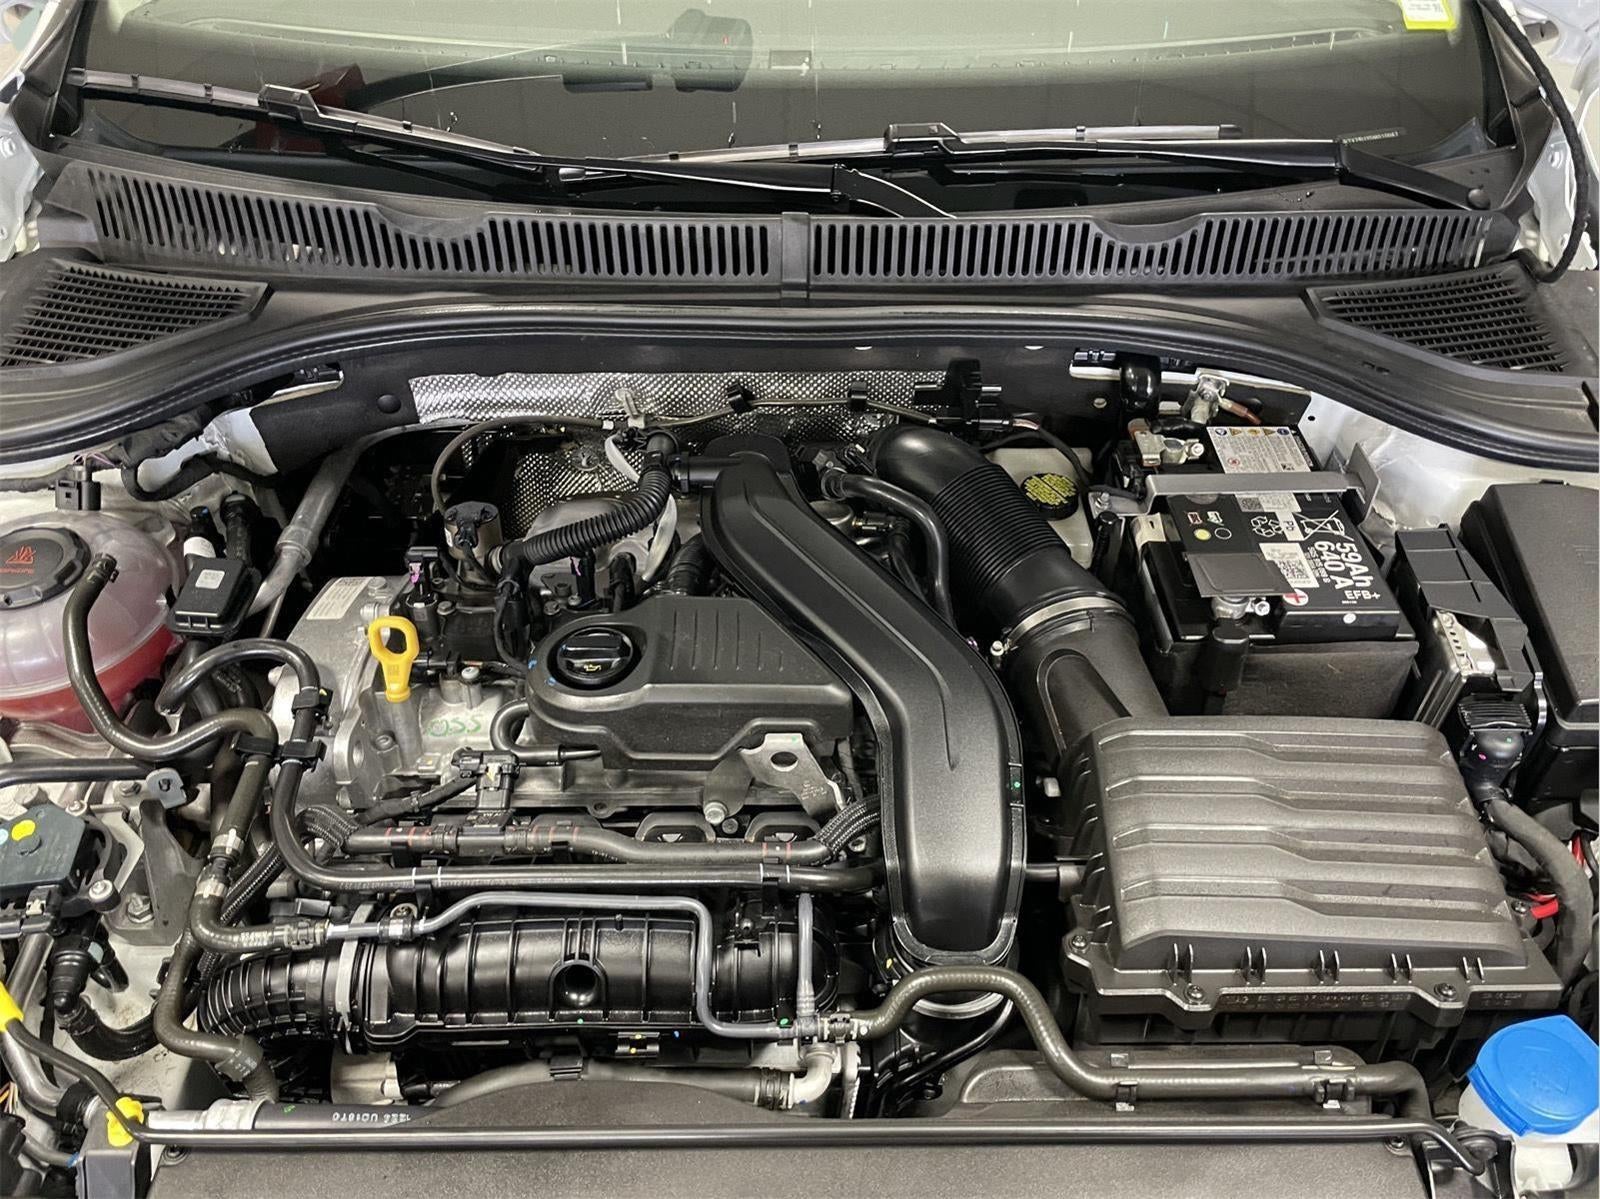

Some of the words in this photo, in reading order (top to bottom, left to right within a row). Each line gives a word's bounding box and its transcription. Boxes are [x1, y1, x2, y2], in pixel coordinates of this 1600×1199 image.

[1314, 540, 1346, 572] 640
[1335, 542, 1374, 588] 59Ah
[1329, 574, 1355, 590] A
[1344, 589, 1381, 600] EFB+
